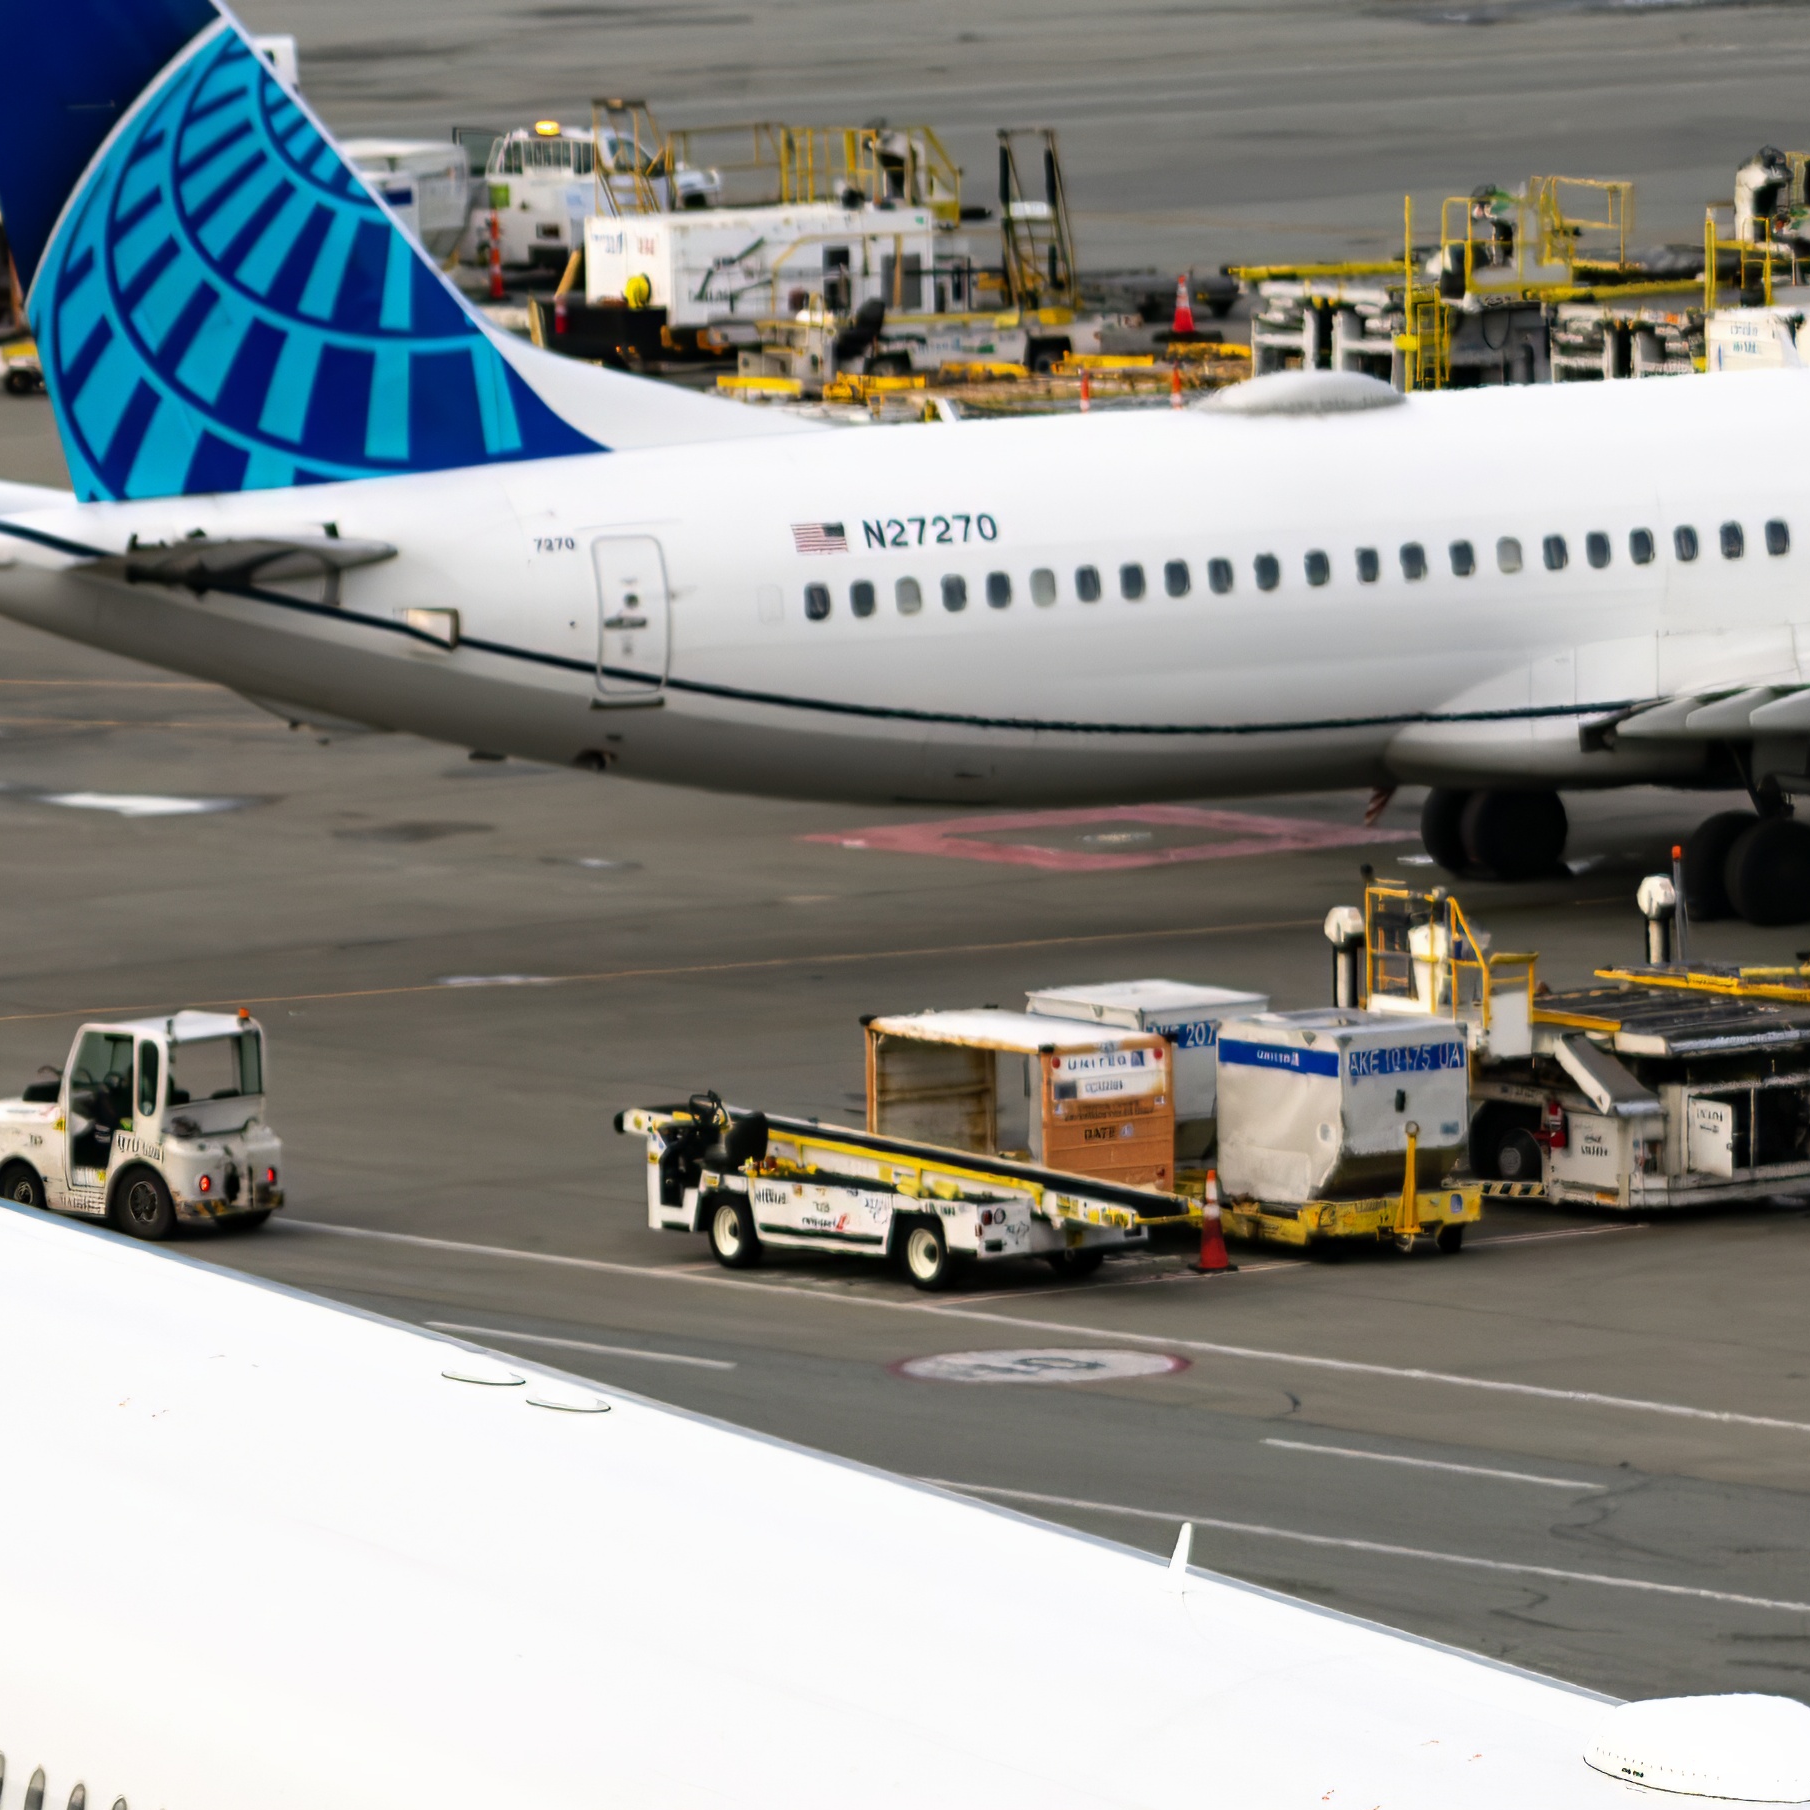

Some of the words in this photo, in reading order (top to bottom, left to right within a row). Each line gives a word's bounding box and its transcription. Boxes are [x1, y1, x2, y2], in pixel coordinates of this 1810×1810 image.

[861, 512, 998, 549] N27270
[533, 537, 576, 553] 7270
[1439, 1042, 1462, 1069] UA
